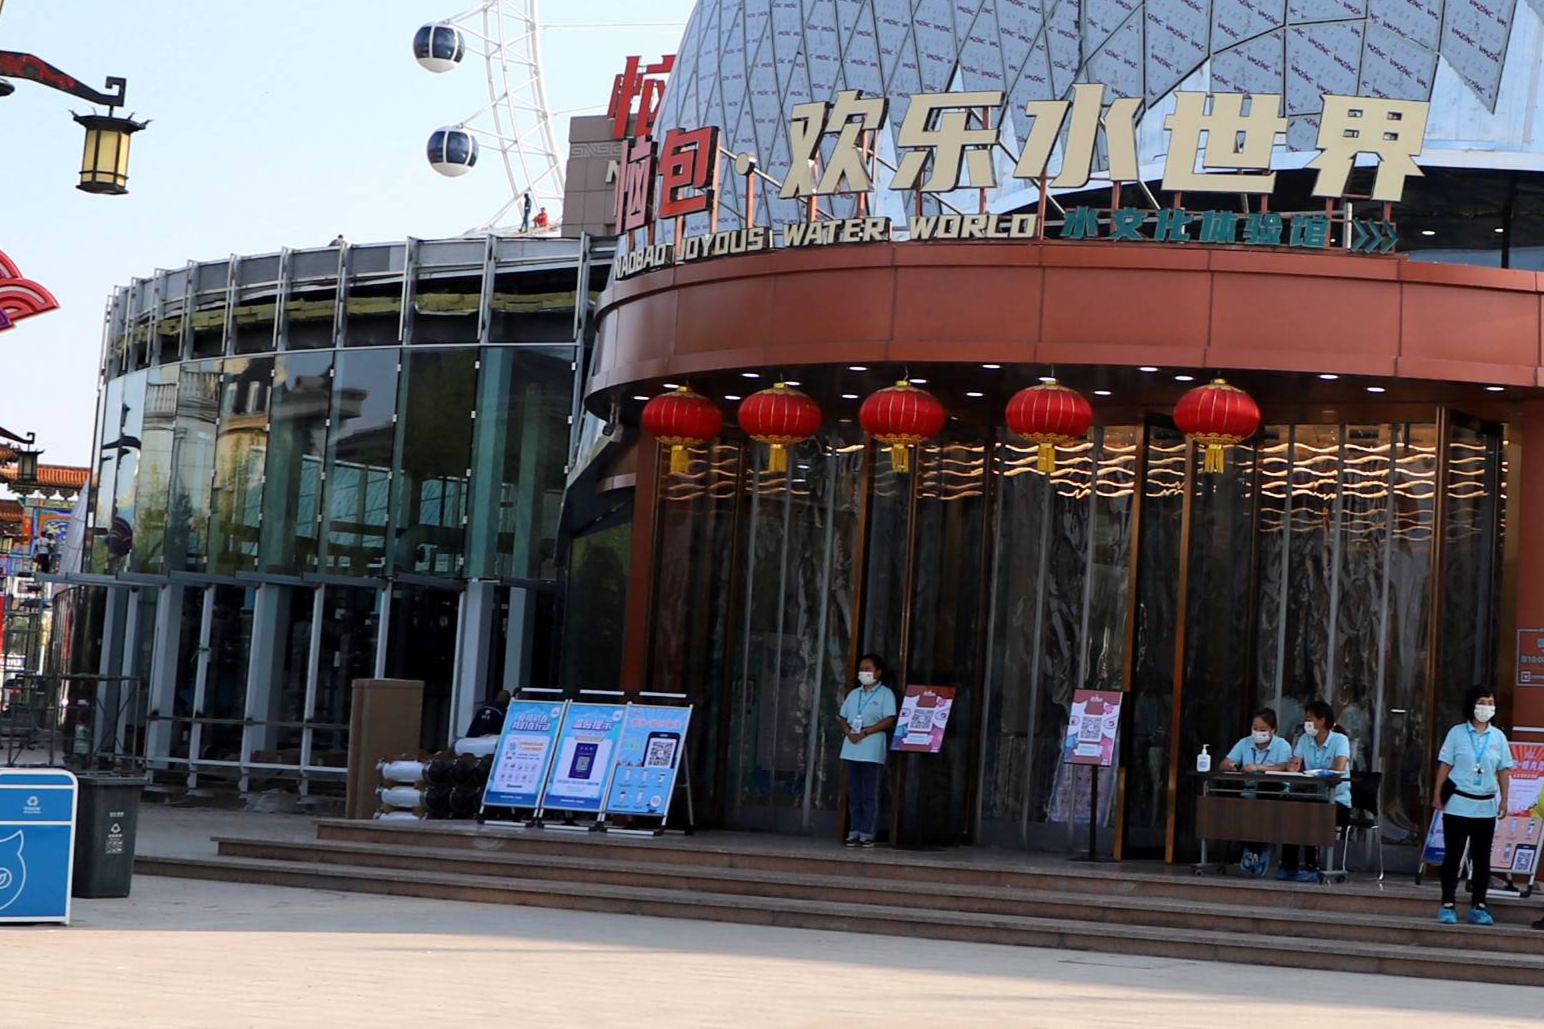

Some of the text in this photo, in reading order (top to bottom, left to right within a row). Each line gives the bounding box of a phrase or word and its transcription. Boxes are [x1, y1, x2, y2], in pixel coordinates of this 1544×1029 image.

[675, 227, 765, 263] JOYOUS
[783, 217, 888, 248] WATER
[910, 213, 1037, 239] WORLD
[1062, 206, 1330, 248] 水文化体验馆
